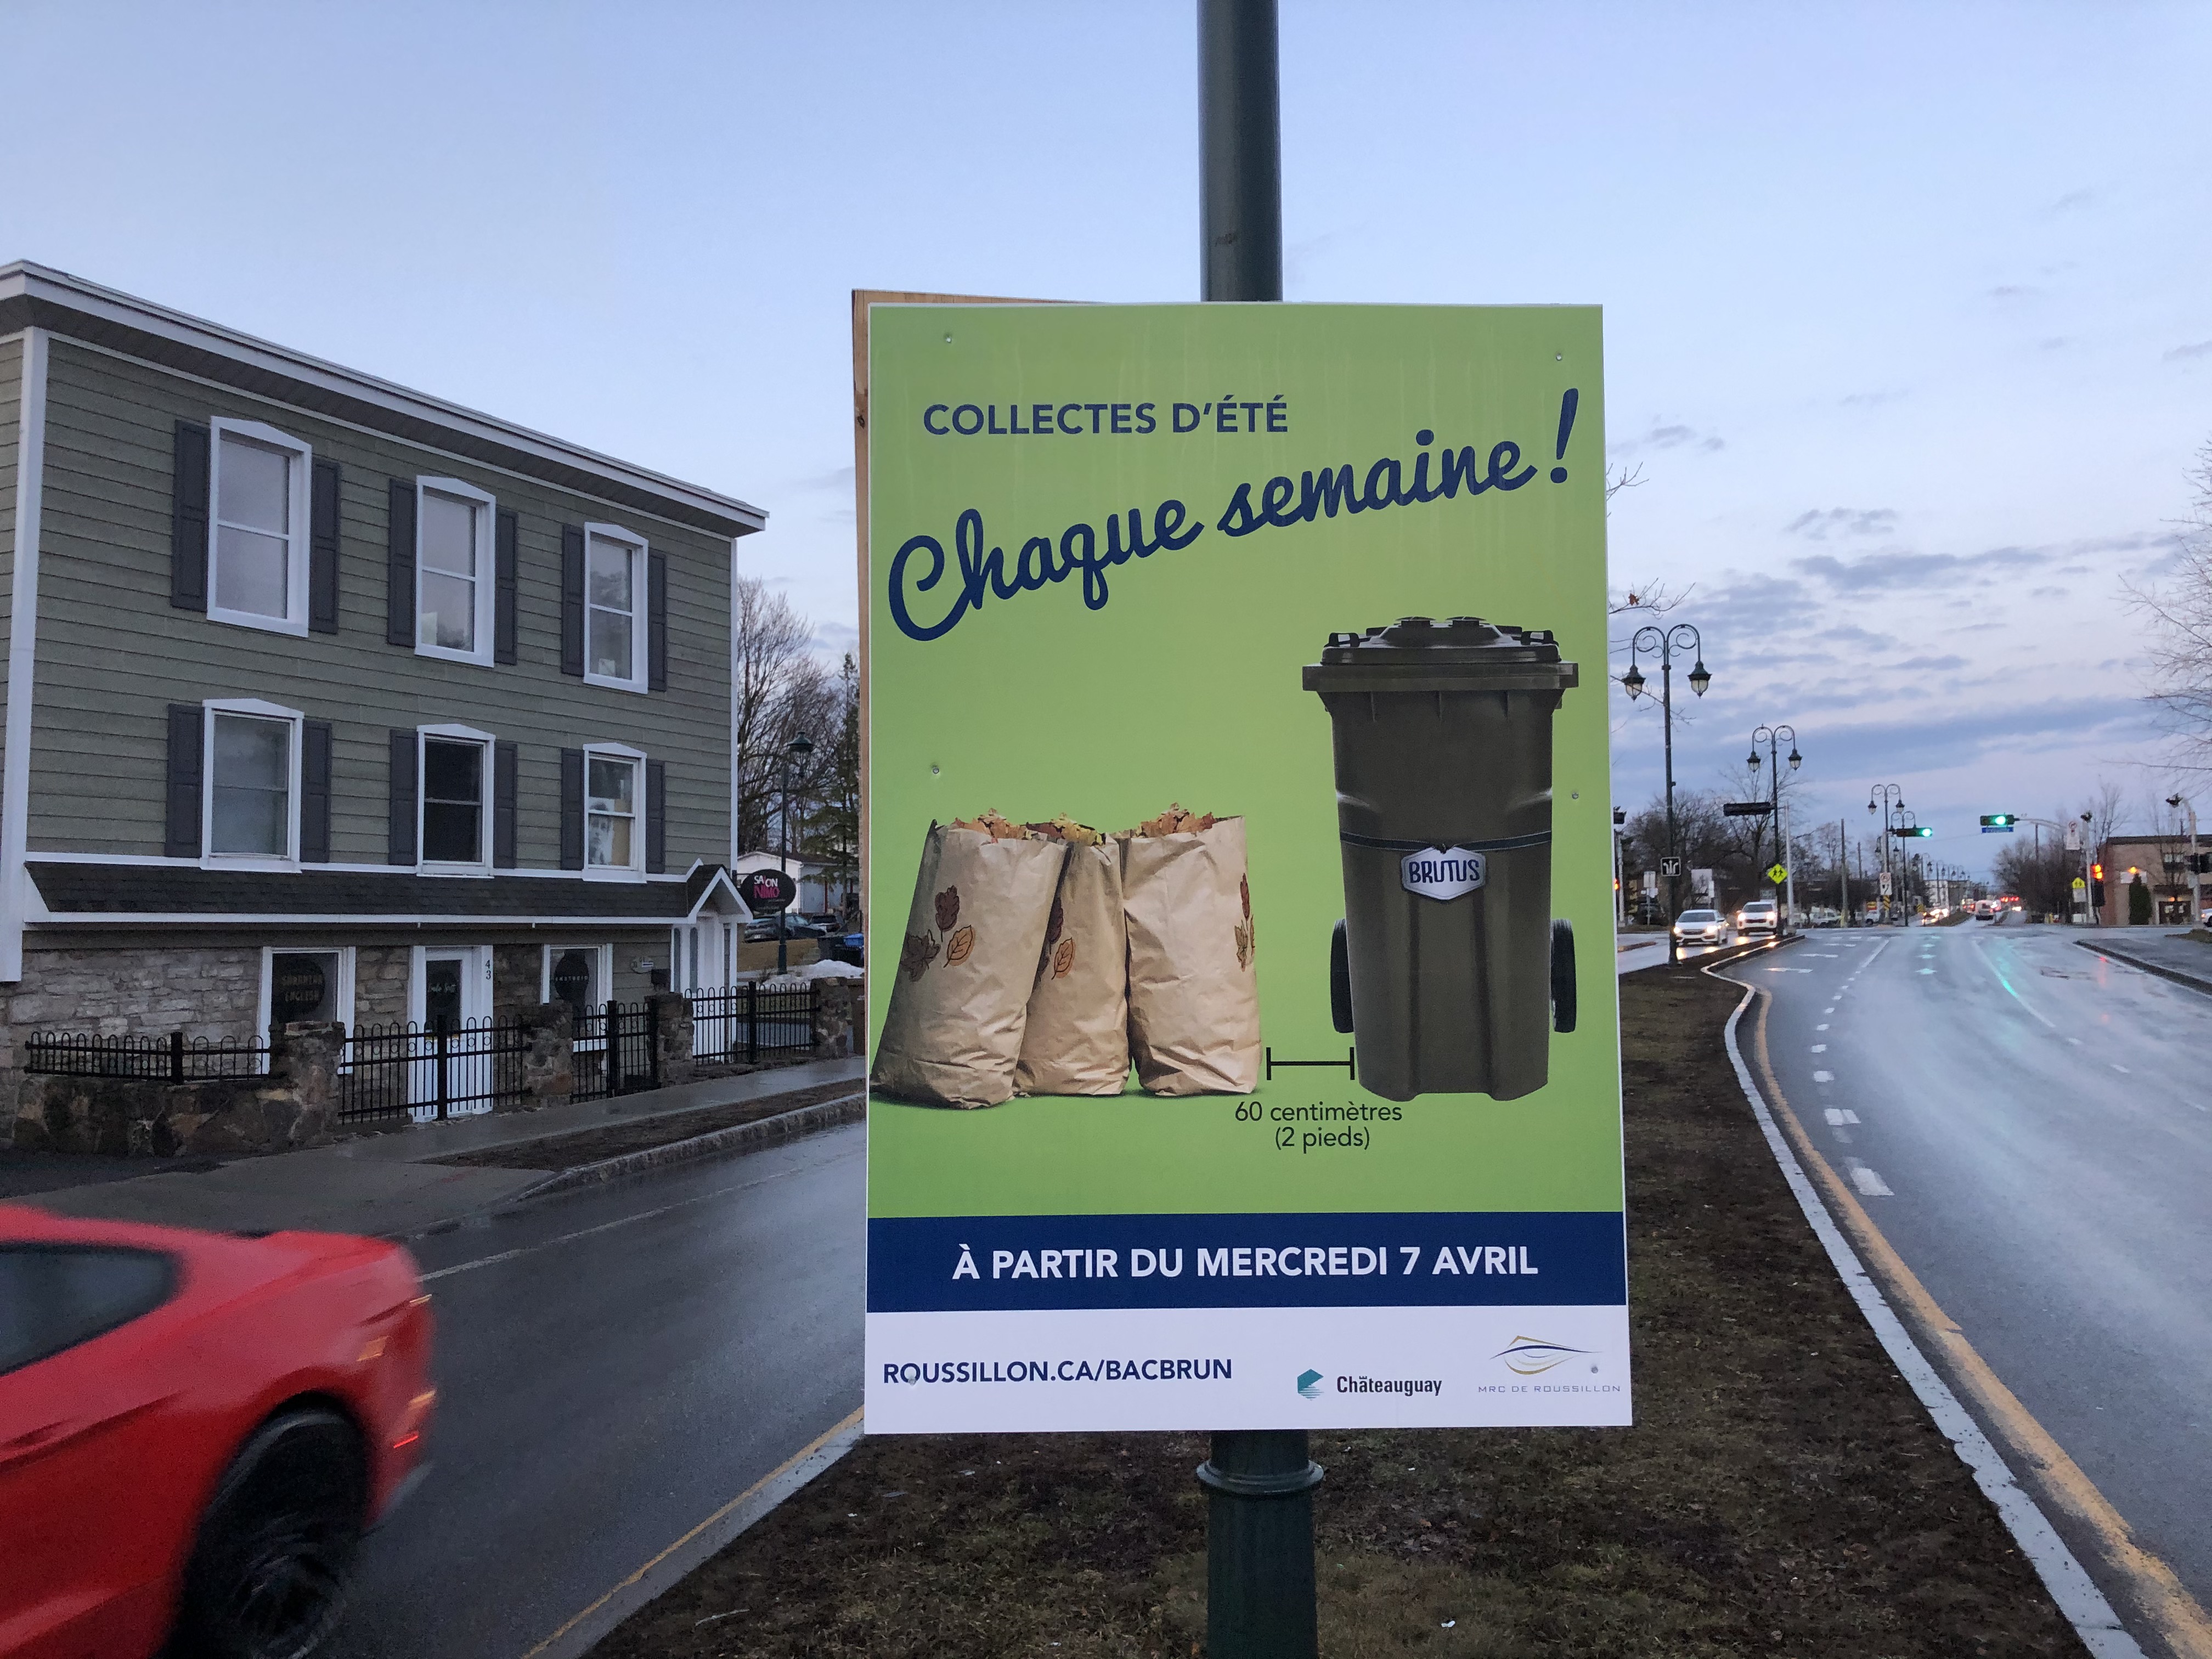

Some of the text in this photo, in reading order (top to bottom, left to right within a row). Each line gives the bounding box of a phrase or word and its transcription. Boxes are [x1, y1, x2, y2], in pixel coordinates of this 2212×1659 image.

[923, 394, 1288, 436] COLLECTES D'ÉTÉ
[888, 499, 1205, 641] Chaque
[1409, 859, 1480, 883] BRUTUS
[1235, 1101, 1403, 1121] 60 centimètres
[1275, 1125, 1370, 1154] (2 pieds)
[952, 1243, 1538, 1279] À PARTIR DU MERCREDI 7 AVRIL
[884, 1359, 1232, 1384] ROUSSILLON.CA/BACBRUN
